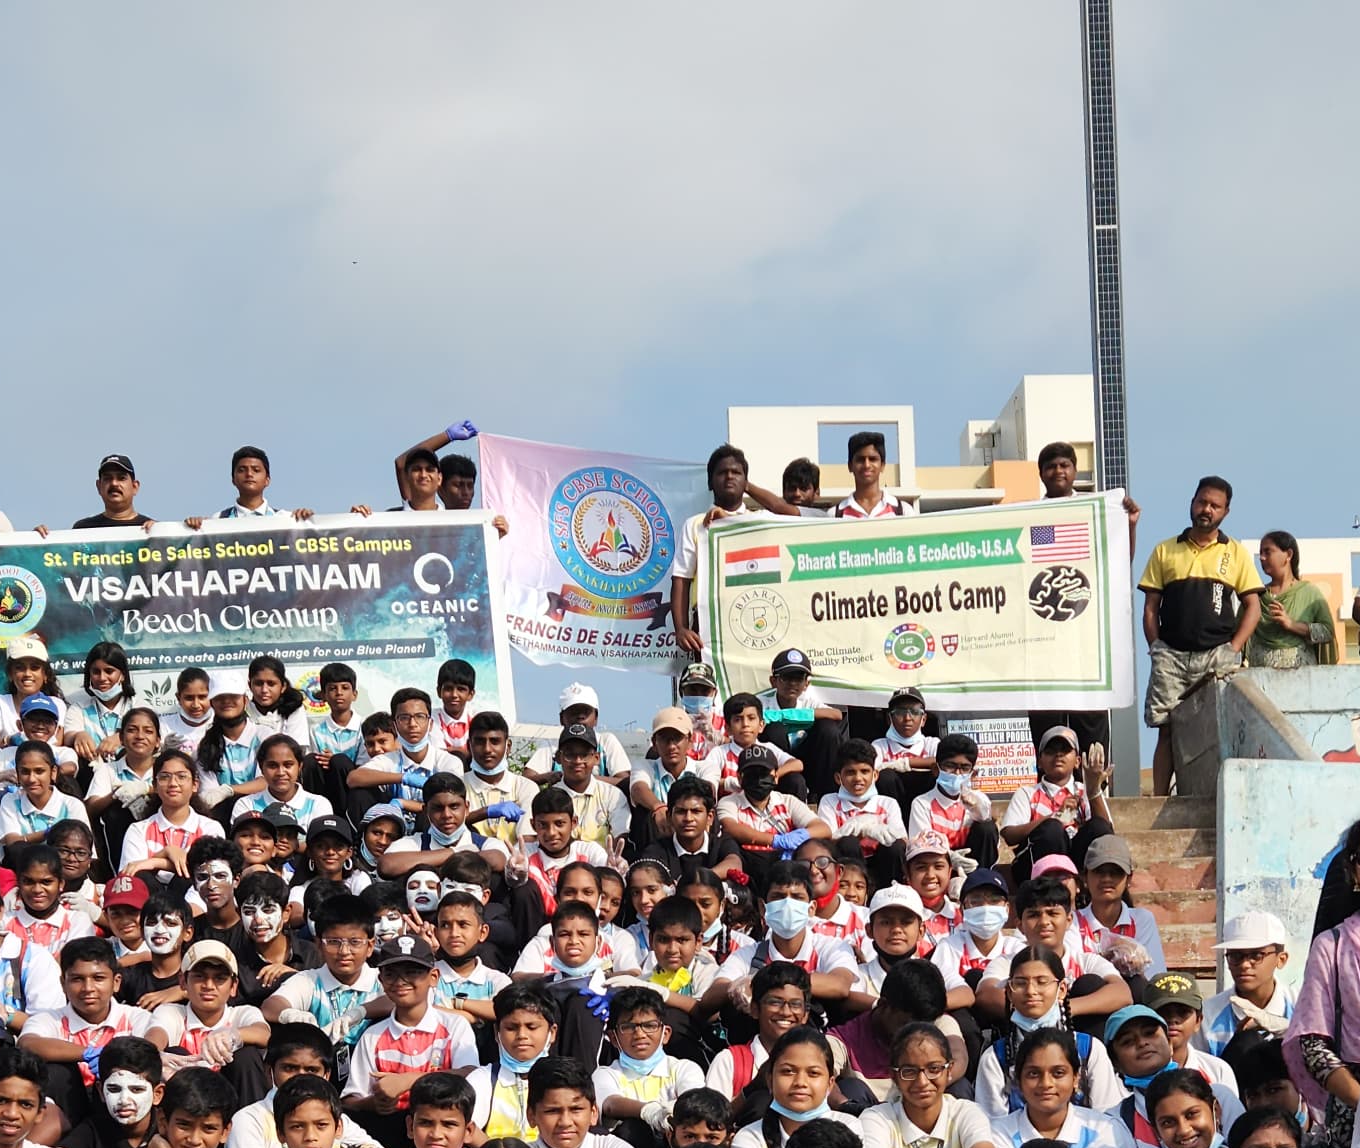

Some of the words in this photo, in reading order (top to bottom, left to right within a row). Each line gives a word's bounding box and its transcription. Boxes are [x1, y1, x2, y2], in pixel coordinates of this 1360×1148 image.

[562, 471, 606, 503] CBSE
[610, 473, 669, 545] SCHOOL
[554, 502, 572, 538] SFS
[44, 552, 67, 568] St.
[72, 549, 134, 567] Francis
[138, 547, 162, 563] De
[167, 543, 213, 560] Sales
[215, 540, 275, 558] School
[295, 537, 339, 554] CBSE
[343, 537, 412, 556] Campus
[798, 550, 836, 572] Bharat
[839, 546, 904, 570] Ekam-India
[907, 548, 916, 562] &
[920, 539, 1014, 563] EcoActUs-U.S.A
[566, 554, 665, 594] VISAKHAPATNAM
[1220, 552, 1231, 576] POLO
[64, 562, 381, 603] VISAKHAPATNAM
[391, 598, 479, 615] OCEANIC
[735, 589, 784, 611] BHARAT
[811, 588, 888, 622] Climate
[895, 584, 942, 615] Boot
[948, 580, 1007, 616] Camp
[1214, 583, 1224, 616] SPORT
[123, 608, 214, 635] Beach
[220, 604, 338, 632] Cleanup
[407, 615, 465, 624] GLOBAL
[506, 614, 572, 641] FRANCIS
[576, 628, 598, 645] DE
[602, 631, 652, 648] SALES
[743, 634, 777, 648] EKAM
[961, 633, 988, 642] Harvard
[990, 631, 1014, 640] Alumni
[163, 654, 172, 664] to
[175, 652, 215, 663] create
[217, 648, 264, 663] positive
[267, 647, 310, 662] change
[313, 646, 327, 658] for
[331, 647, 354, 657] our
[356, 645, 382, 656] Blue
[384, 643, 426, 656] Planet!
[807, 648, 824, 658] The
[825, 647, 861, 657] Climate
[994, 639, 1006, 647] and
[600, 649, 678, 660] VISAKHAPATNAM
[842, 653, 873, 667] Project
[989, 722, 1007, 730] AVOID
[979, 731, 1005, 744] HEALTH
[745, 746, 768, 760] BOY
[988, 767, 1008, 777] 8899
[1010, 766, 1029, 775] 1111
[112, 876, 133, 894] 46
